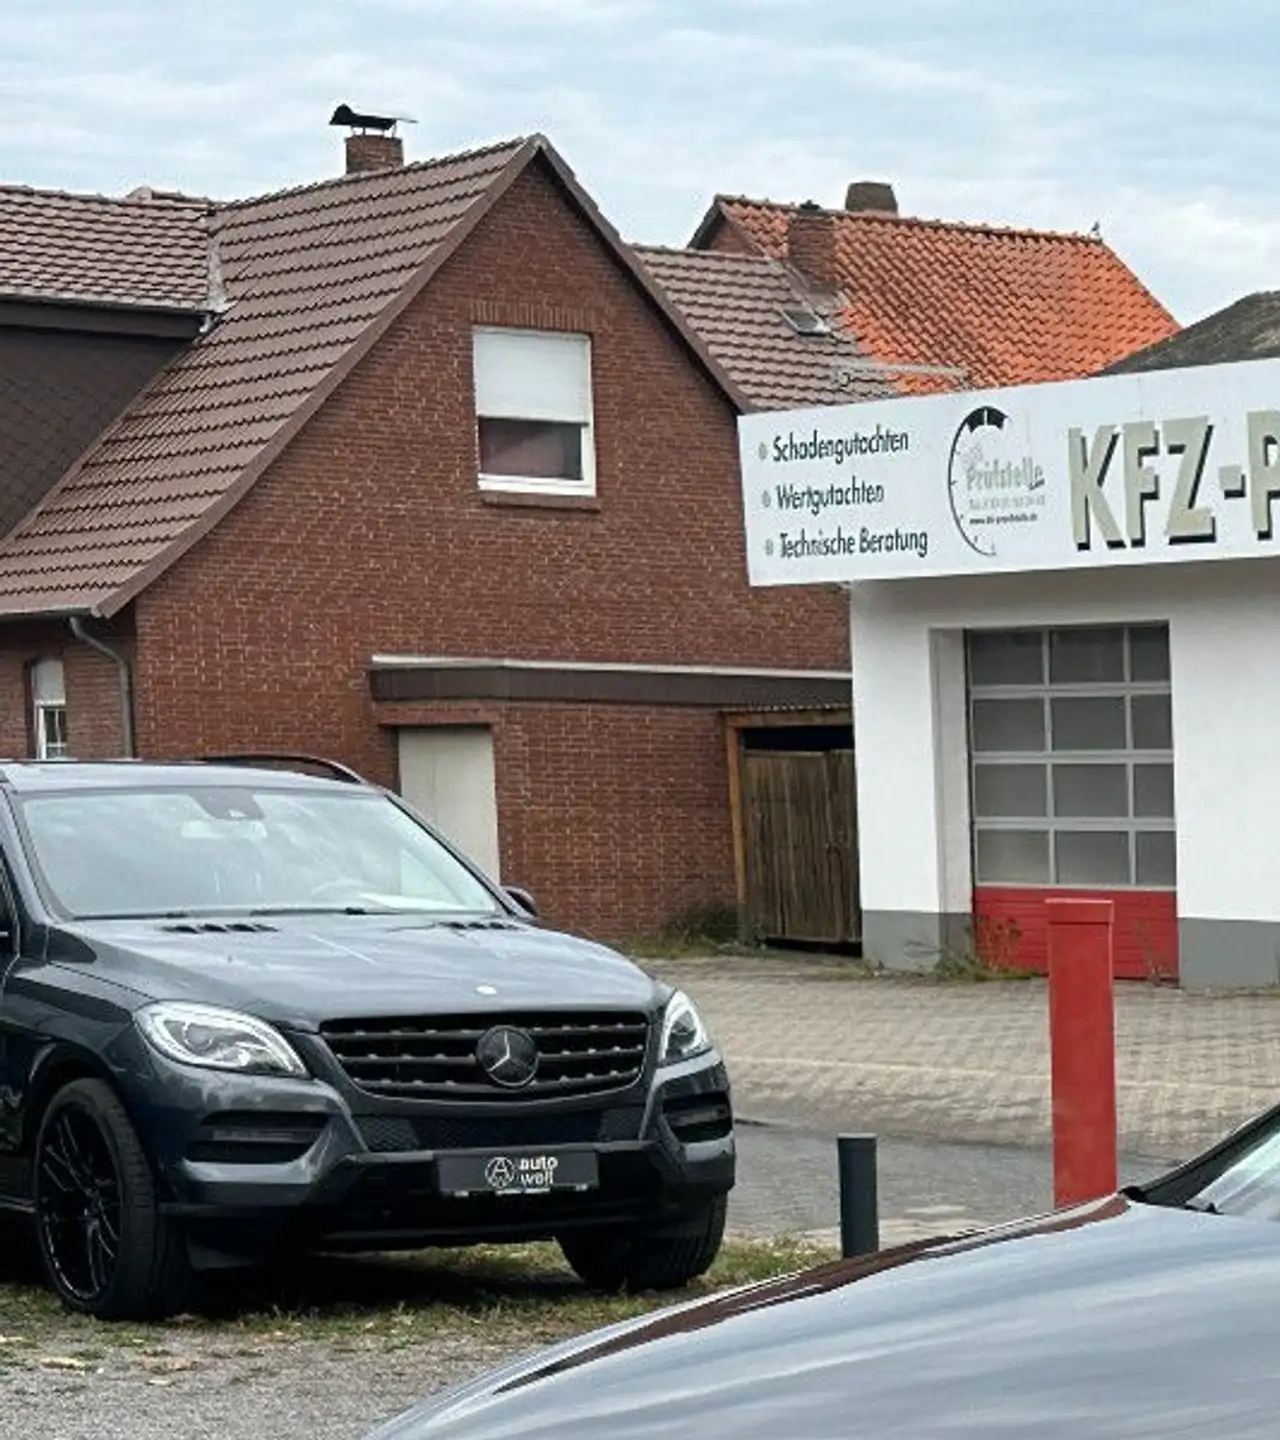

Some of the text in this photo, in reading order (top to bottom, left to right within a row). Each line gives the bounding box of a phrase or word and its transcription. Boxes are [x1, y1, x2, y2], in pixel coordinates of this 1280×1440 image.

[772, 424, 909, 464] Schadengutachten
[776, 475, 885, 516] Wertgutachten
[780, 526, 928, 558] Technische Beratung
